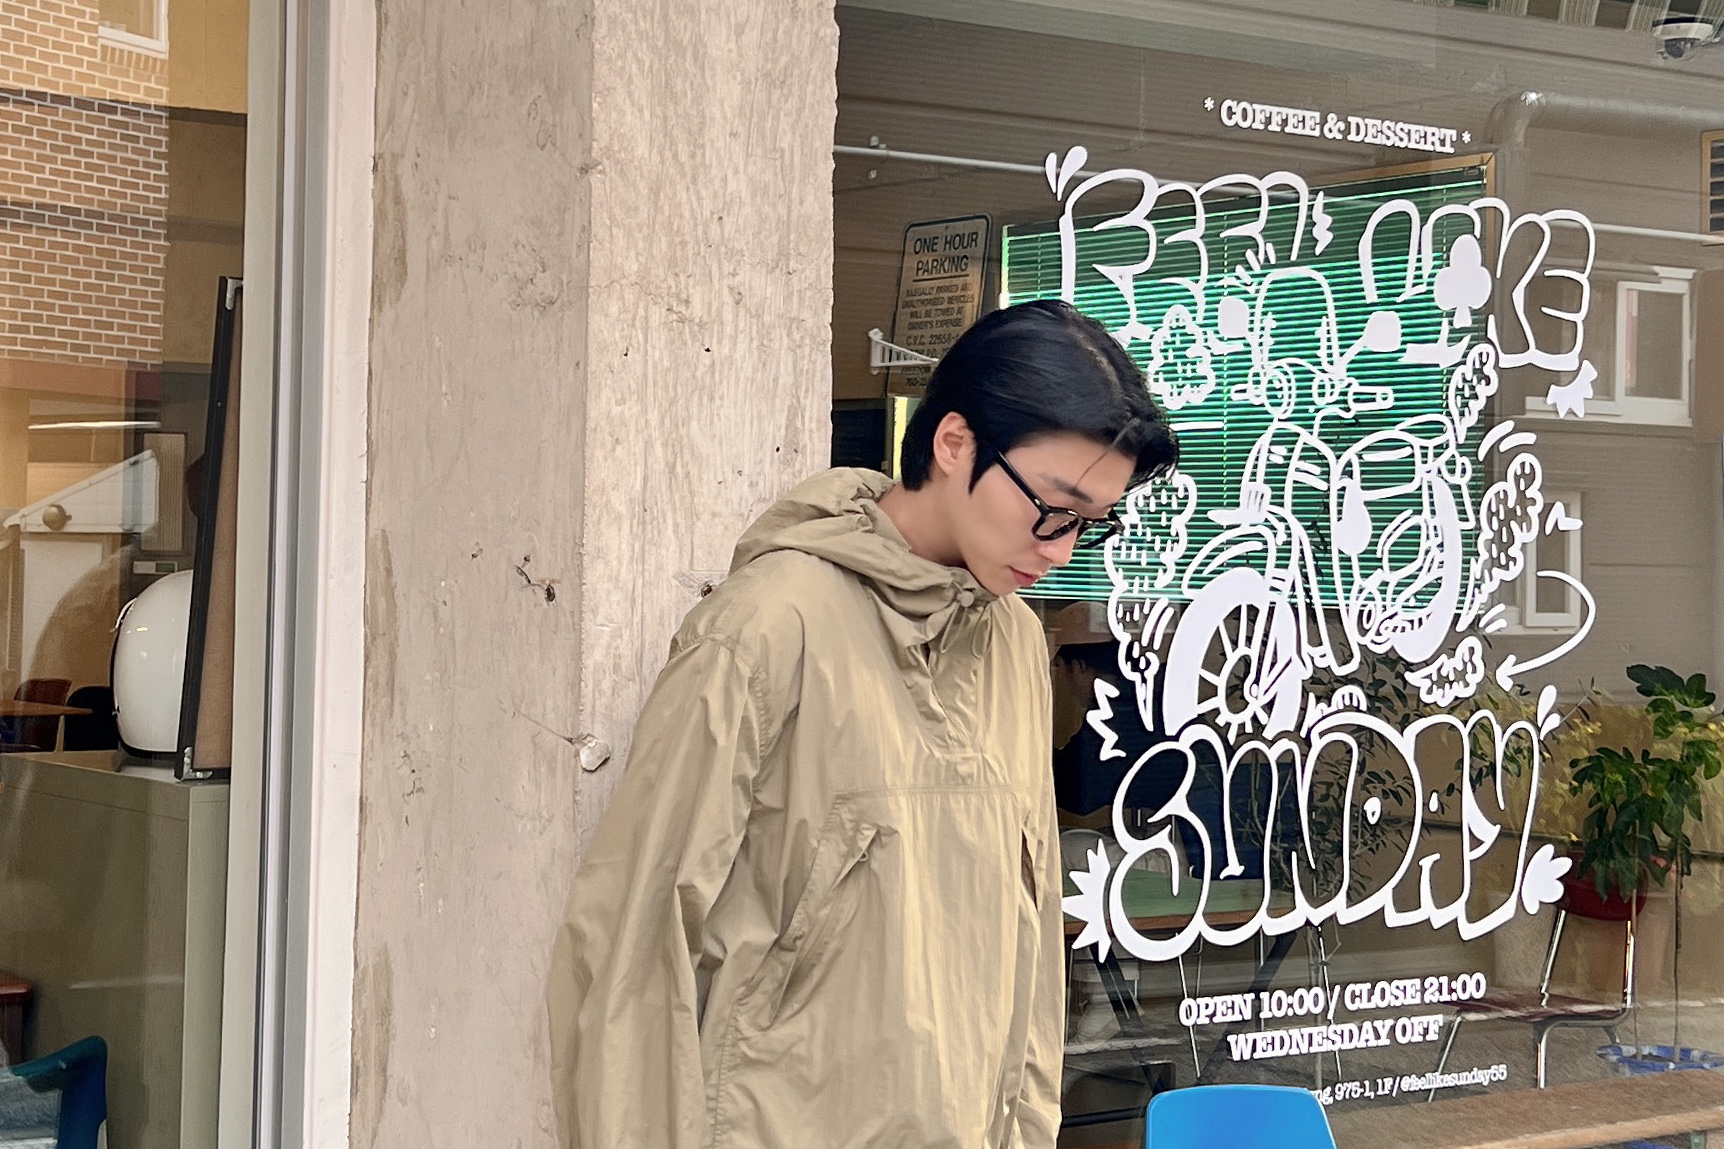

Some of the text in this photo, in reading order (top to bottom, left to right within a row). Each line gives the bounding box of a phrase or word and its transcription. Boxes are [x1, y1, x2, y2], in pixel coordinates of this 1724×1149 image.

[1219, 98, 1457, 153] COFFEE & DESSERT
[913, 231, 979, 255] ONE HOUR
[915, 254, 969, 277] PARKING
[1111, 708, 1541, 963] SUNDAY
[1179, 972, 1487, 1026] OPEN 10:00 / CLOSE 21:00
[1227, 1014, 1444, 1062] WEDNESDAY OFF
[1335, 1080, 1375, 1101] 975-1,
